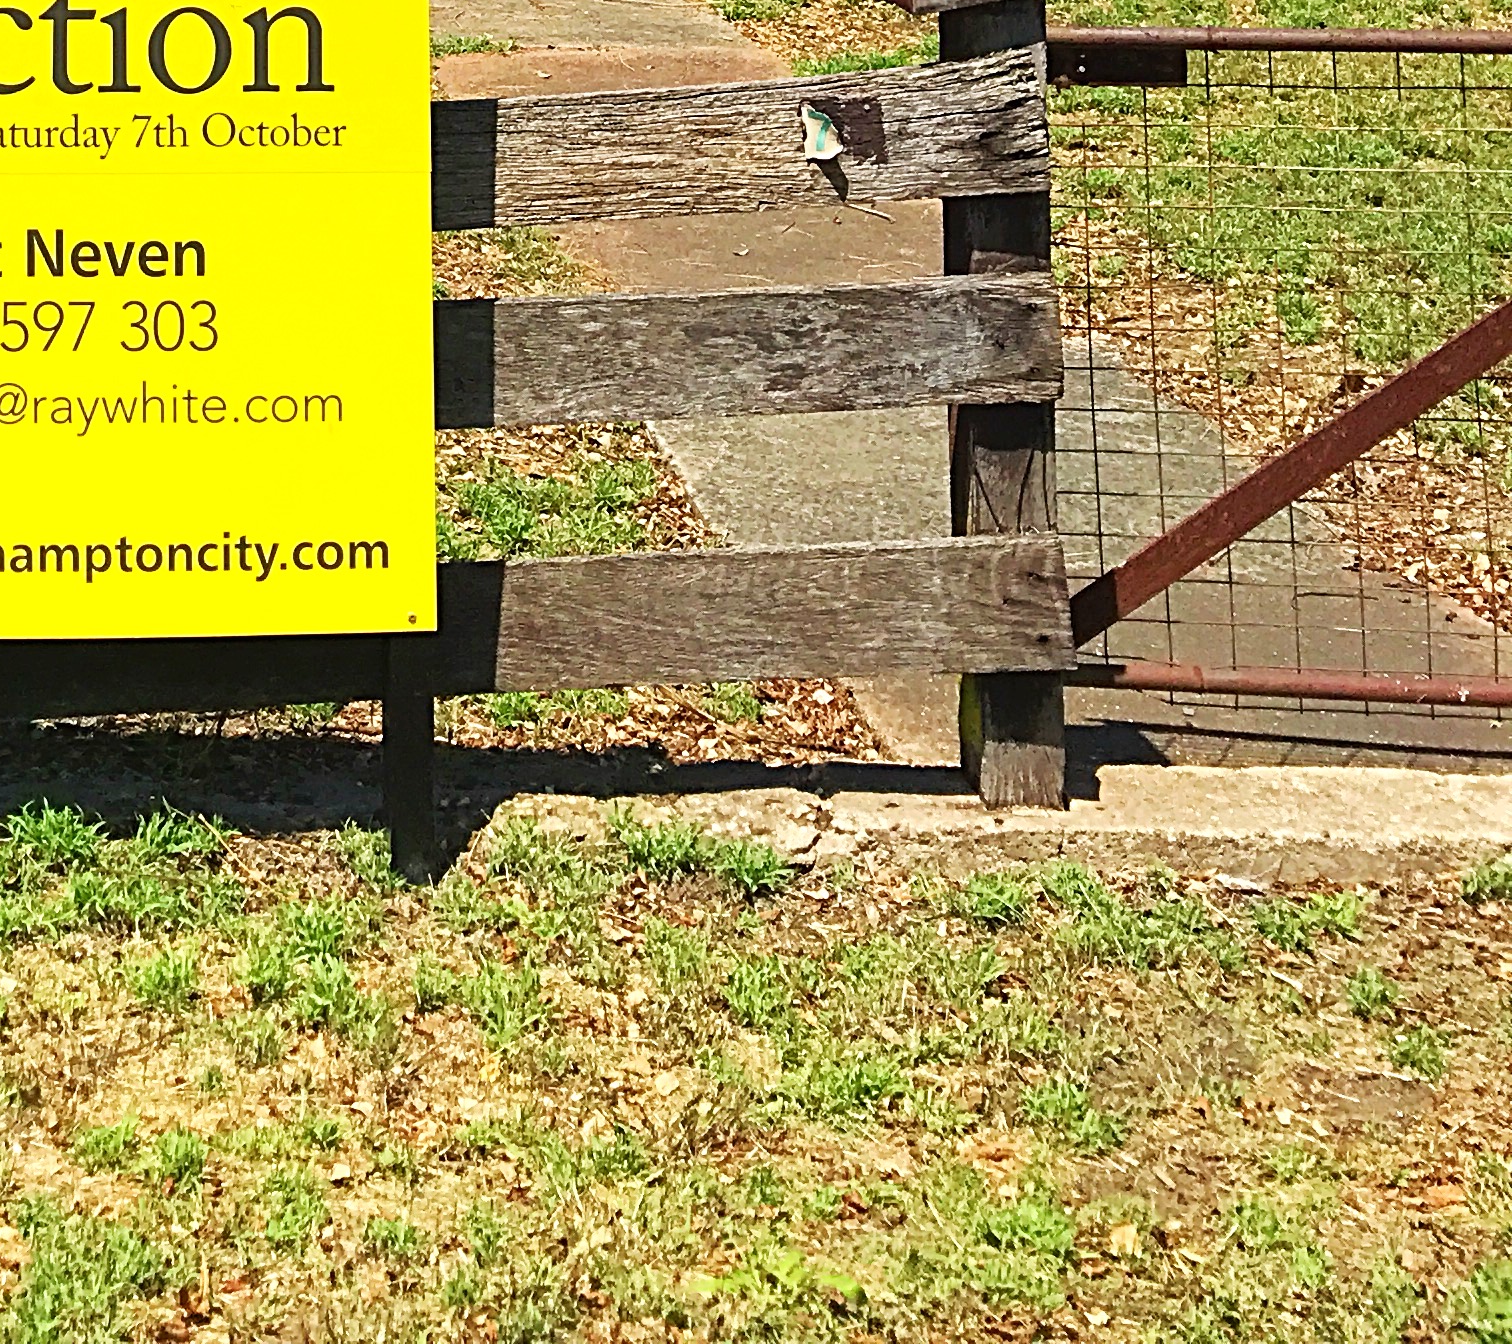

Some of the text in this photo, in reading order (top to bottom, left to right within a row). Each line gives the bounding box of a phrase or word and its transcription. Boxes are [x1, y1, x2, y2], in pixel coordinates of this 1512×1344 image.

[132, 113, 189, 148] 7th
[202, 112, 347, 148] October
[26, 229, 205, 278] Neven
[0, 300, 96, 353] 597
[120, 300, 218, 352] 303
